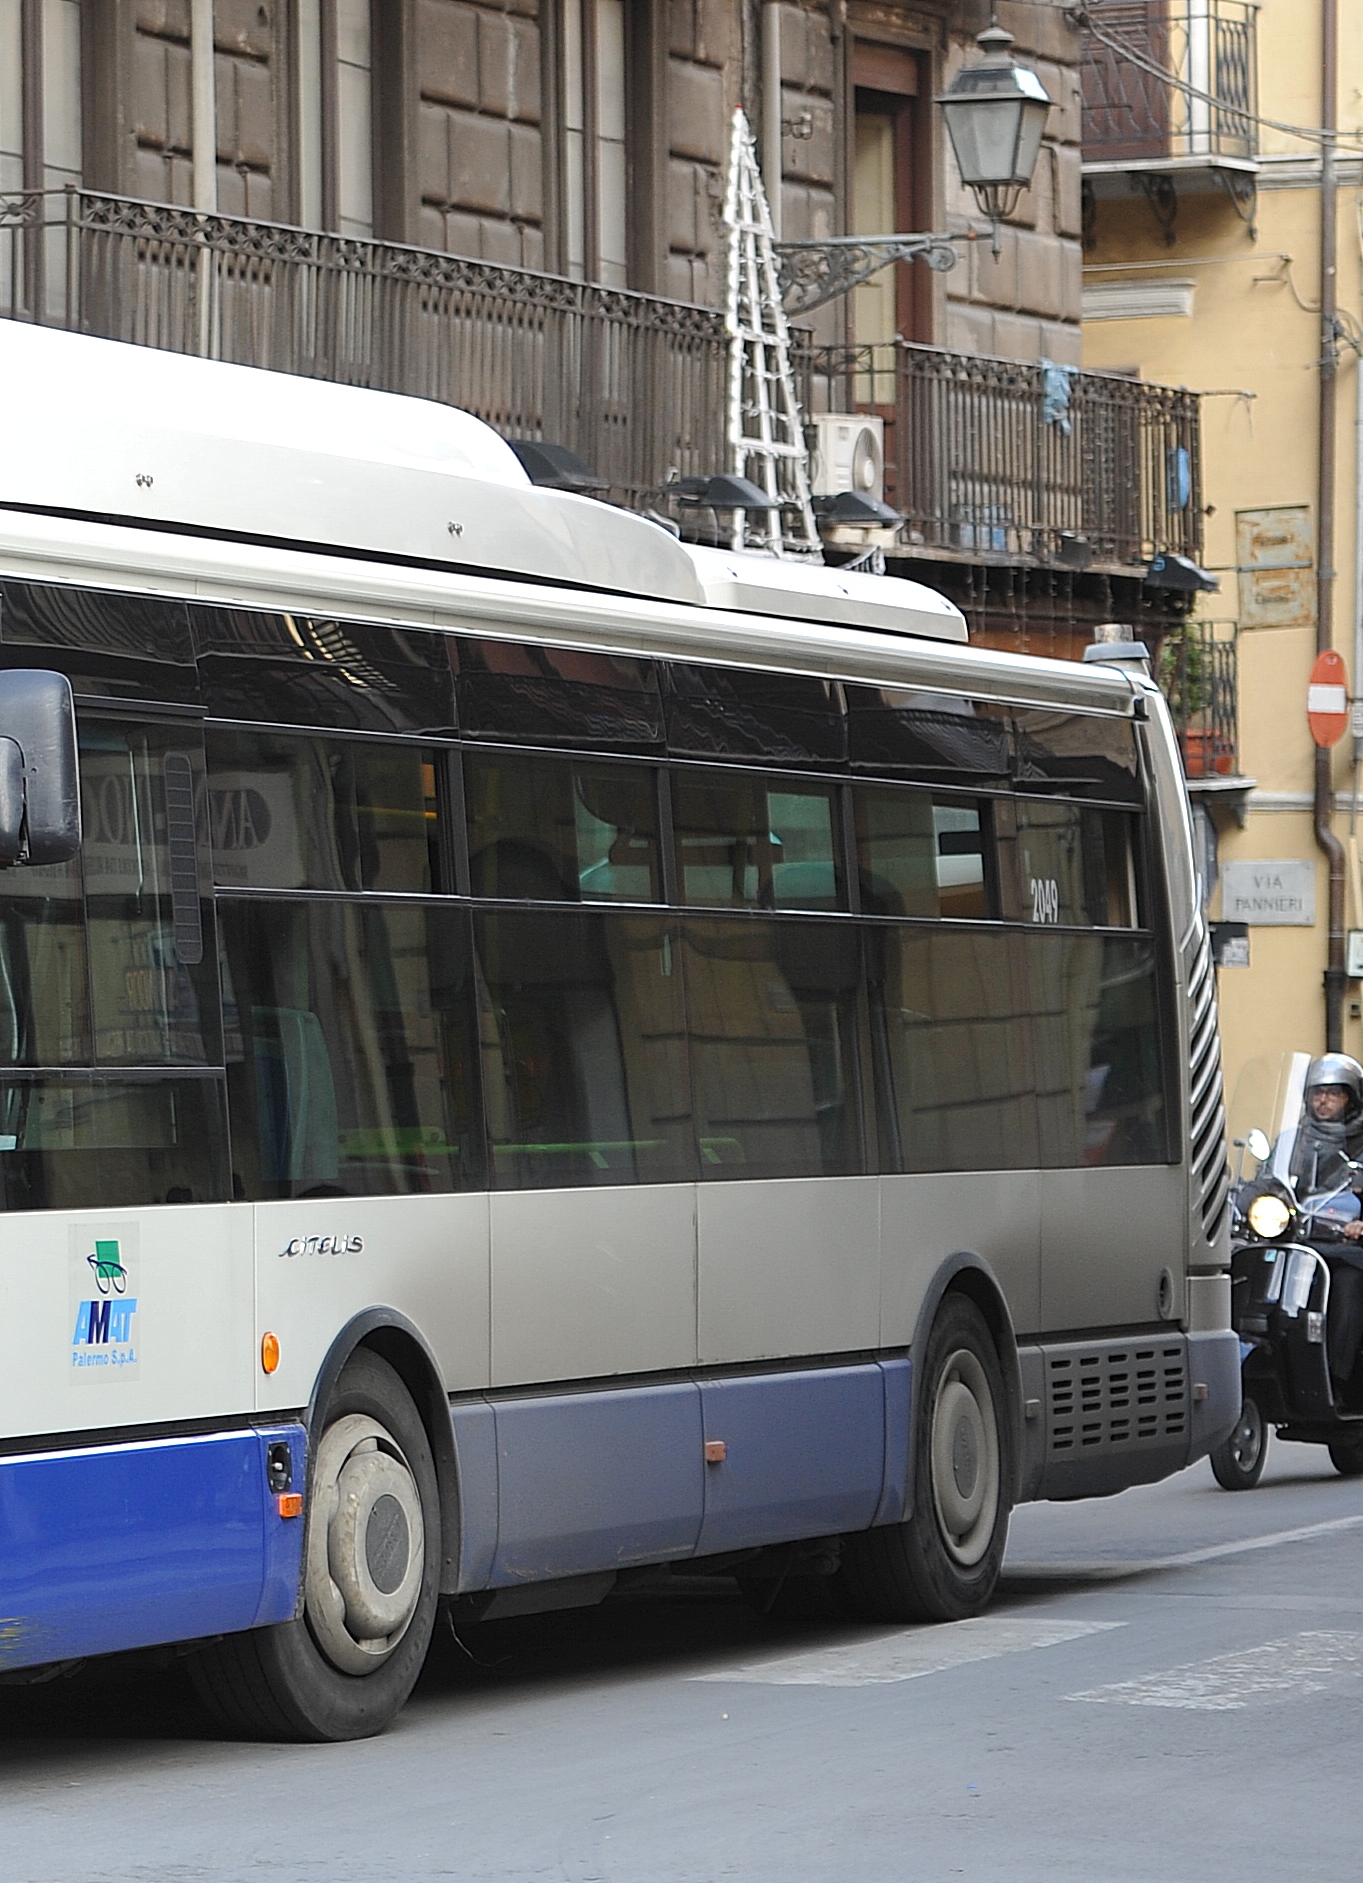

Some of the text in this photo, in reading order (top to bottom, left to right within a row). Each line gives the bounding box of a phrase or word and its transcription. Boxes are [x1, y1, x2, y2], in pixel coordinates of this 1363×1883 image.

[1253, 875, 1284, 890] VIA
[1030, 878, 1059, 924] 2049
[1235, 898, 1304, 912] PANNIERI
[71, 1299, 138, 1346] AMAT
[71, 1348, 138, 1368] Palermo S.p.A.
